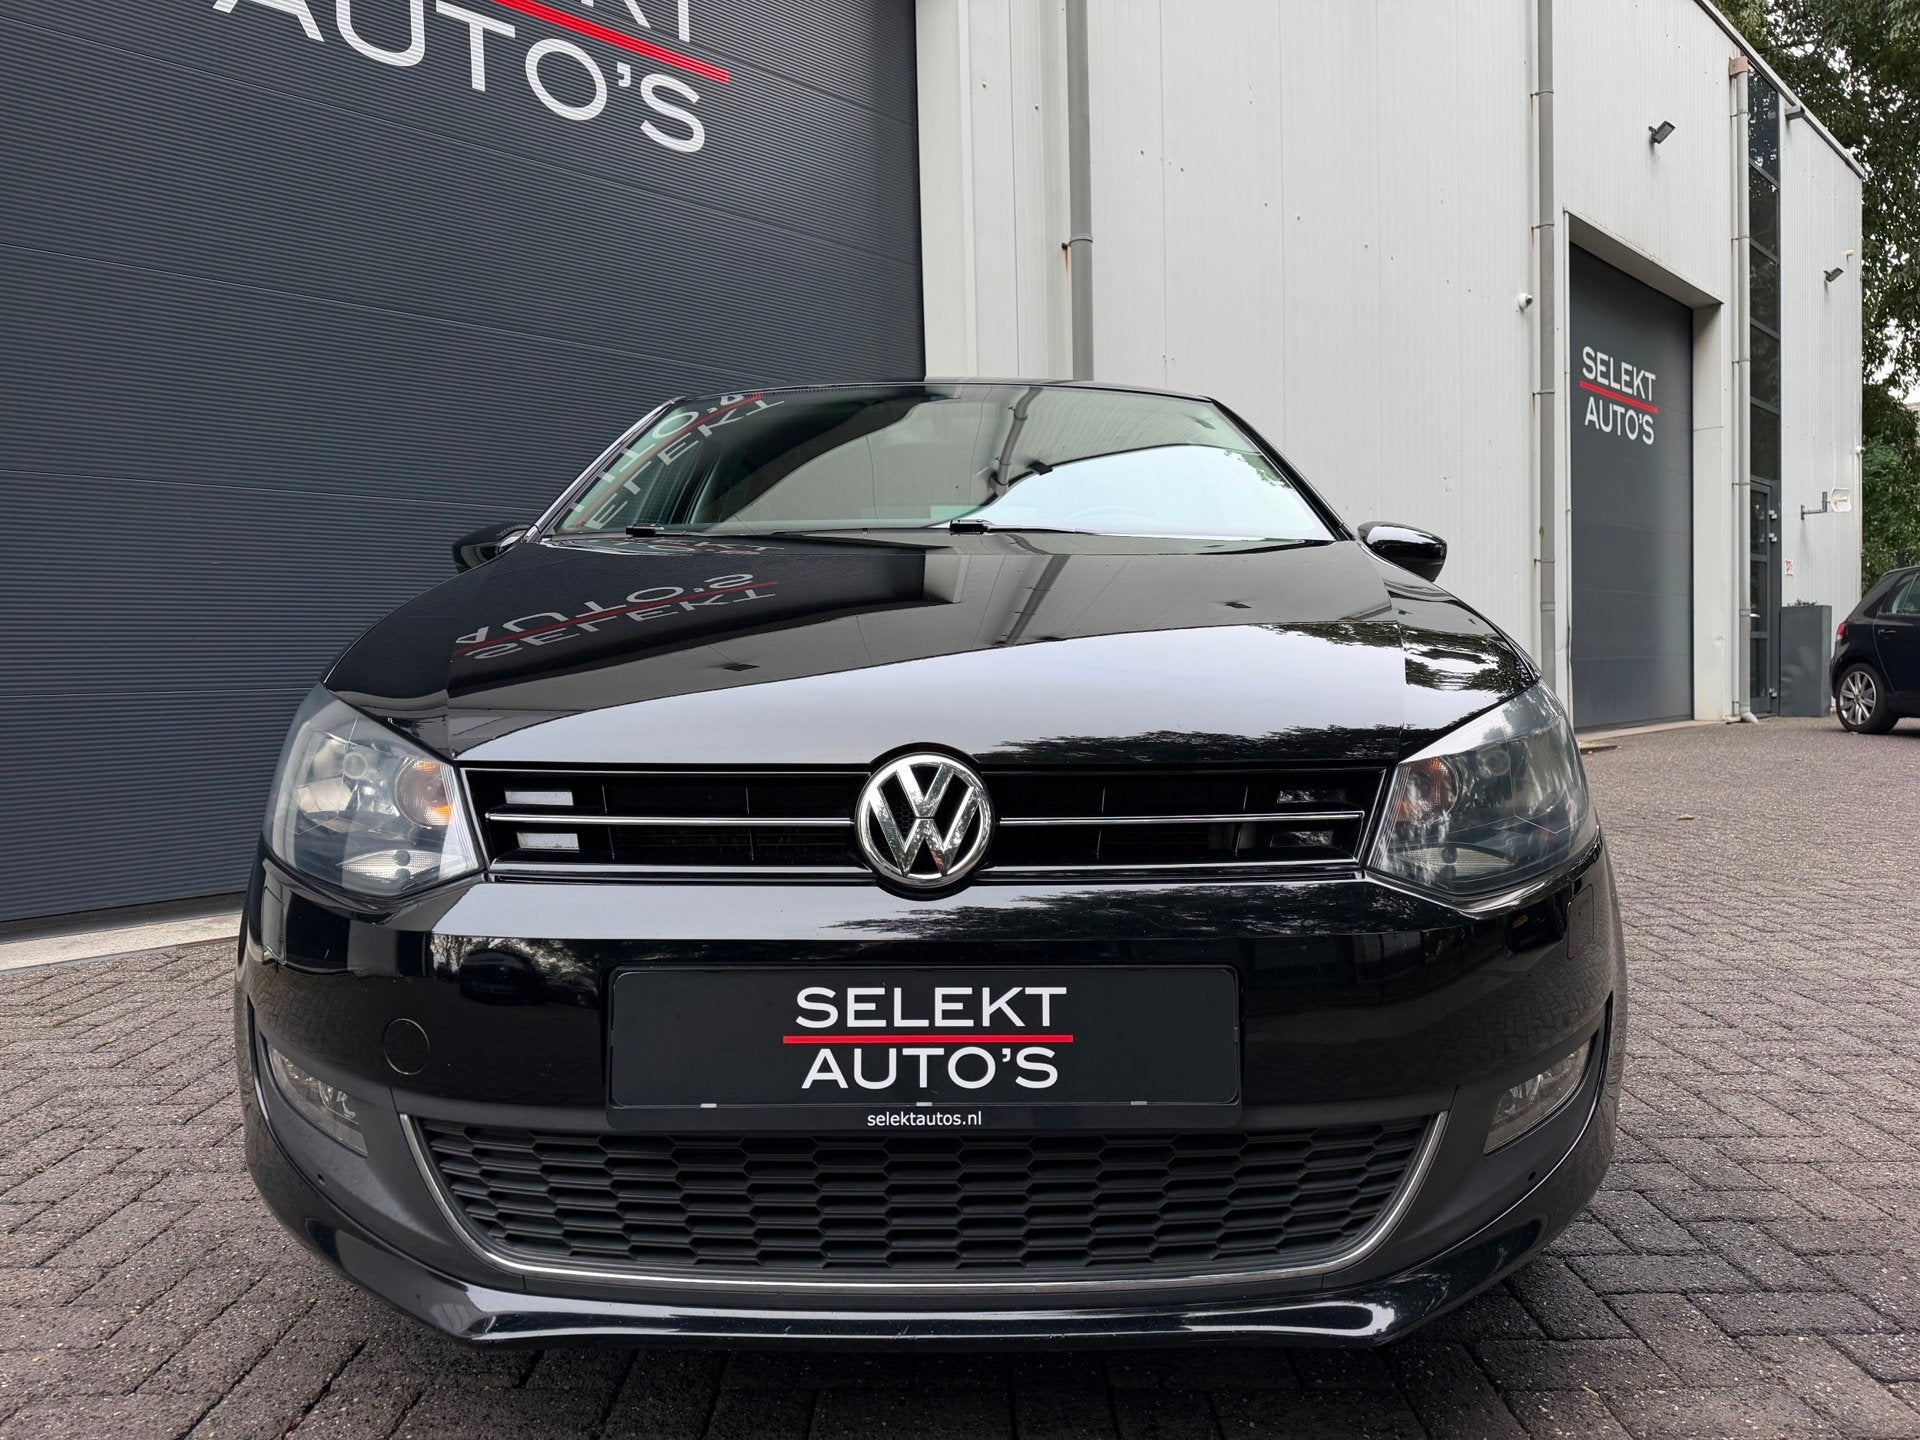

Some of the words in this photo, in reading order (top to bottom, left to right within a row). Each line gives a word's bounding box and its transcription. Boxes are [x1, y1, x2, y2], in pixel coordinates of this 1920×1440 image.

[1582, 346, 1656, 401] SELEKT
[1584, 396, 1655, 445] AUTO'S
[796, 987, 1067, 1028] SELEKT
[801, 1046, 1059, 1089] AUTO'S
[866, 1110, 982, 1127] selektautos.nl
